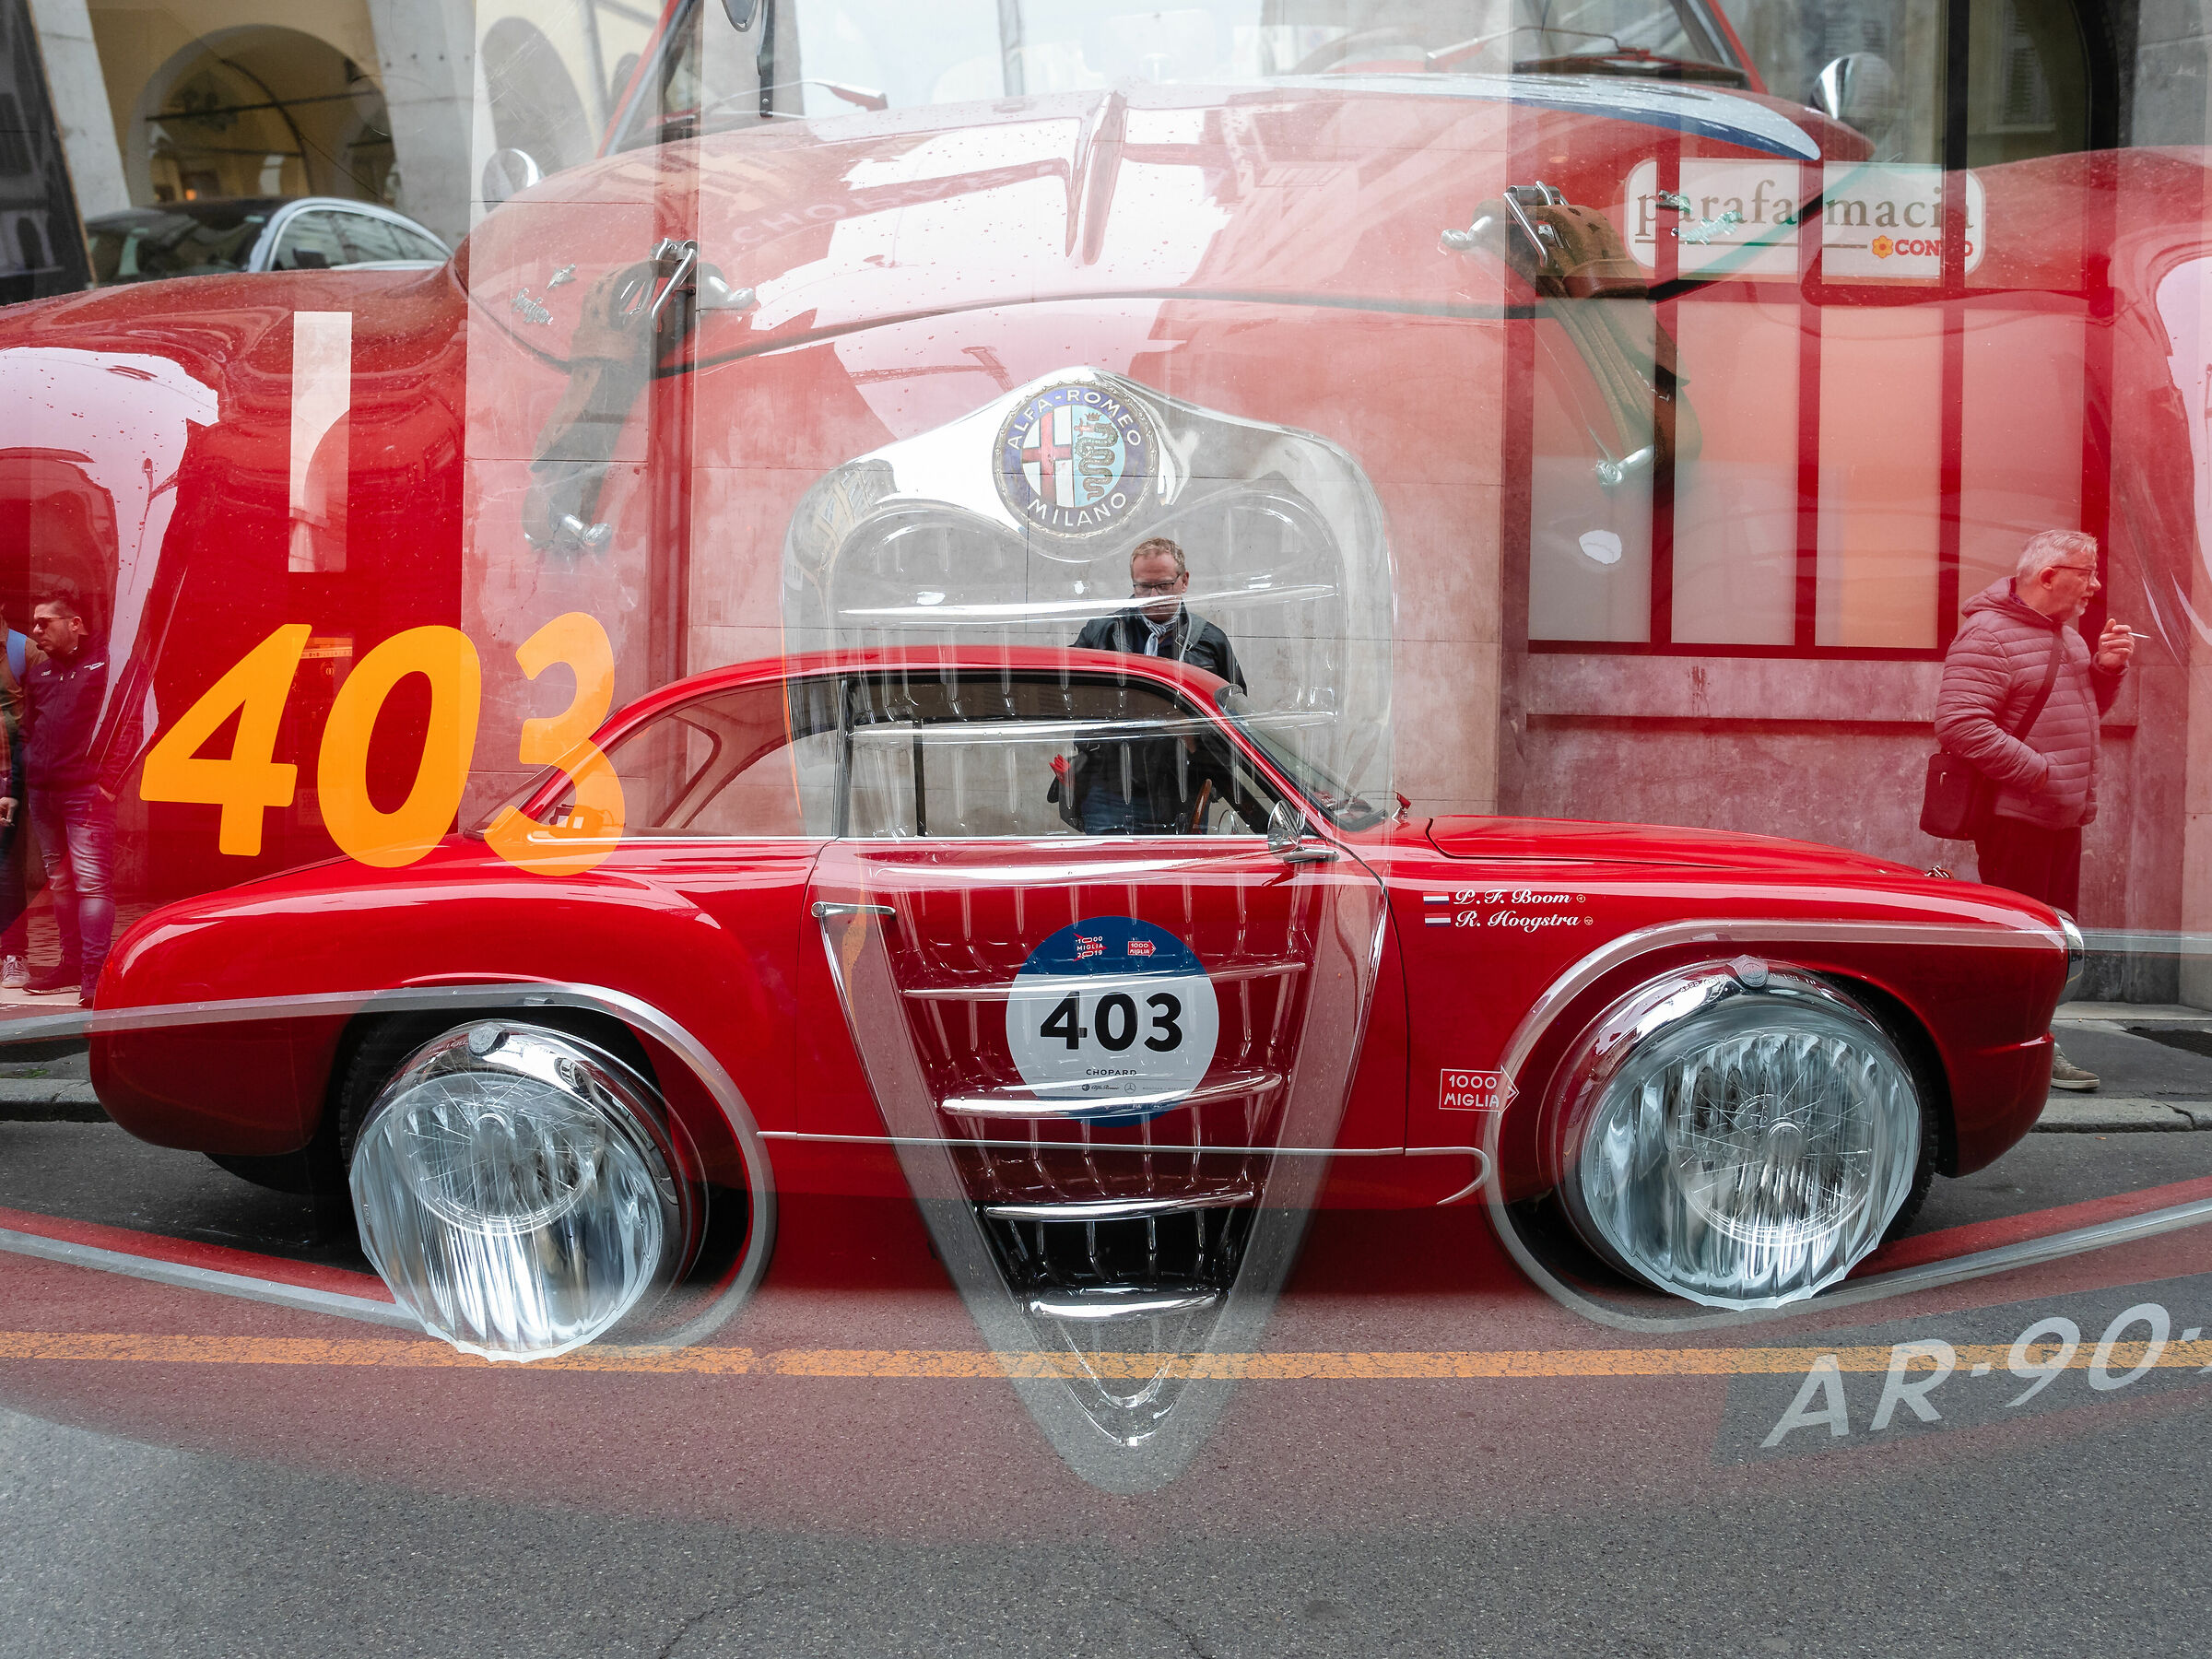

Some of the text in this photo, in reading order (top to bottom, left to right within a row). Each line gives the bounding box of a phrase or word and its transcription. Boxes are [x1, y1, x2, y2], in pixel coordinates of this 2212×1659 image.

[1895, 239, 1973, 257] COND
[1027, 492, 1126, 527] MILANO
[140, 612, 625, 877] 403
[1511, 888, 1572, 904] Boom
[1455, 910, 1581, 933] R. Hoogstra
[1077, 943, 1103, 951] MIGLIA
[1077, 950, 1103, 959] 2019
[1041, 991, 1182, 1052] 403
[1086, 1068, 1137, 1077] CHOPARD
[1449, 1074, 1497, 1089] 1000
[1443, 1092, 1500, 1108] MIGLIA
